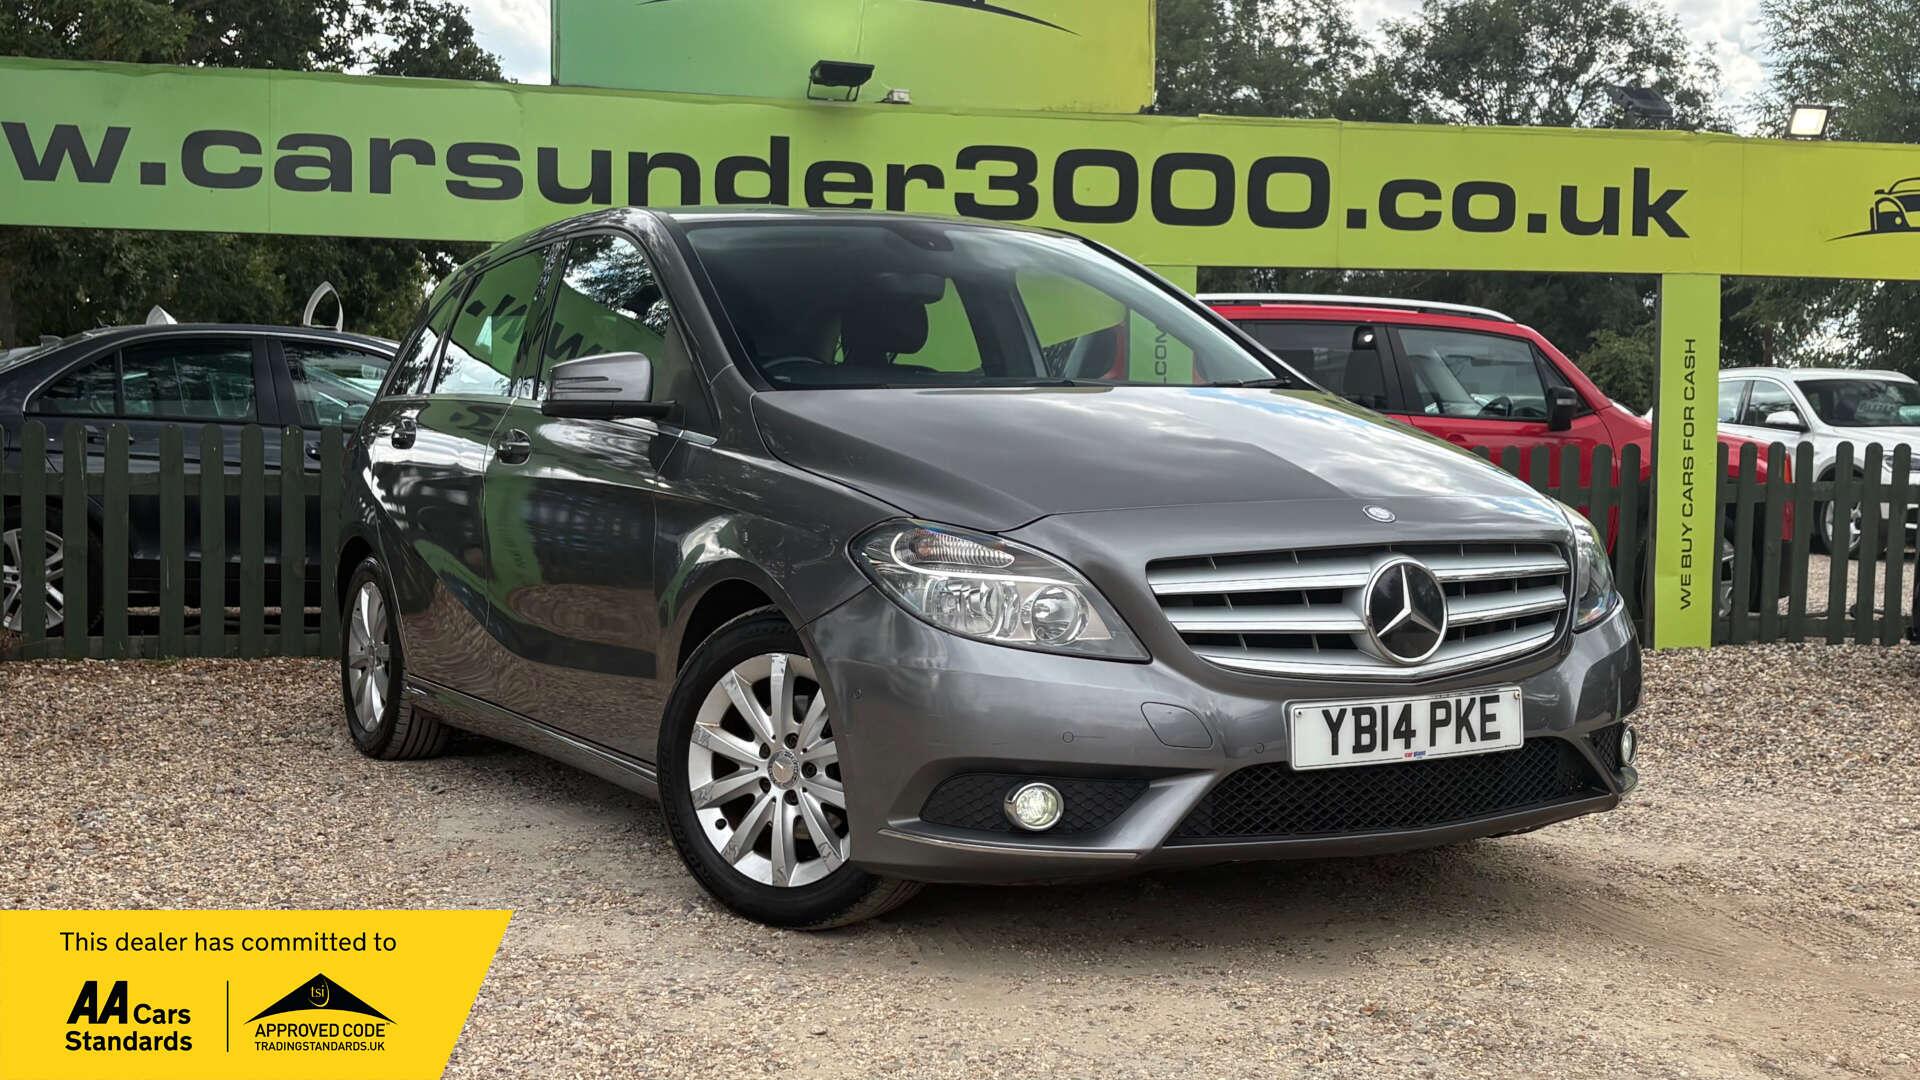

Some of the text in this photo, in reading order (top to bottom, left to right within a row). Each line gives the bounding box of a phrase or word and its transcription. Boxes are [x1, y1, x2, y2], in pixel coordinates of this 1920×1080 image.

[1679, 338, 1696, 610] WE BUY CARS FOR CASH
[1321, 694, 1501, 756] YB14 PKE
